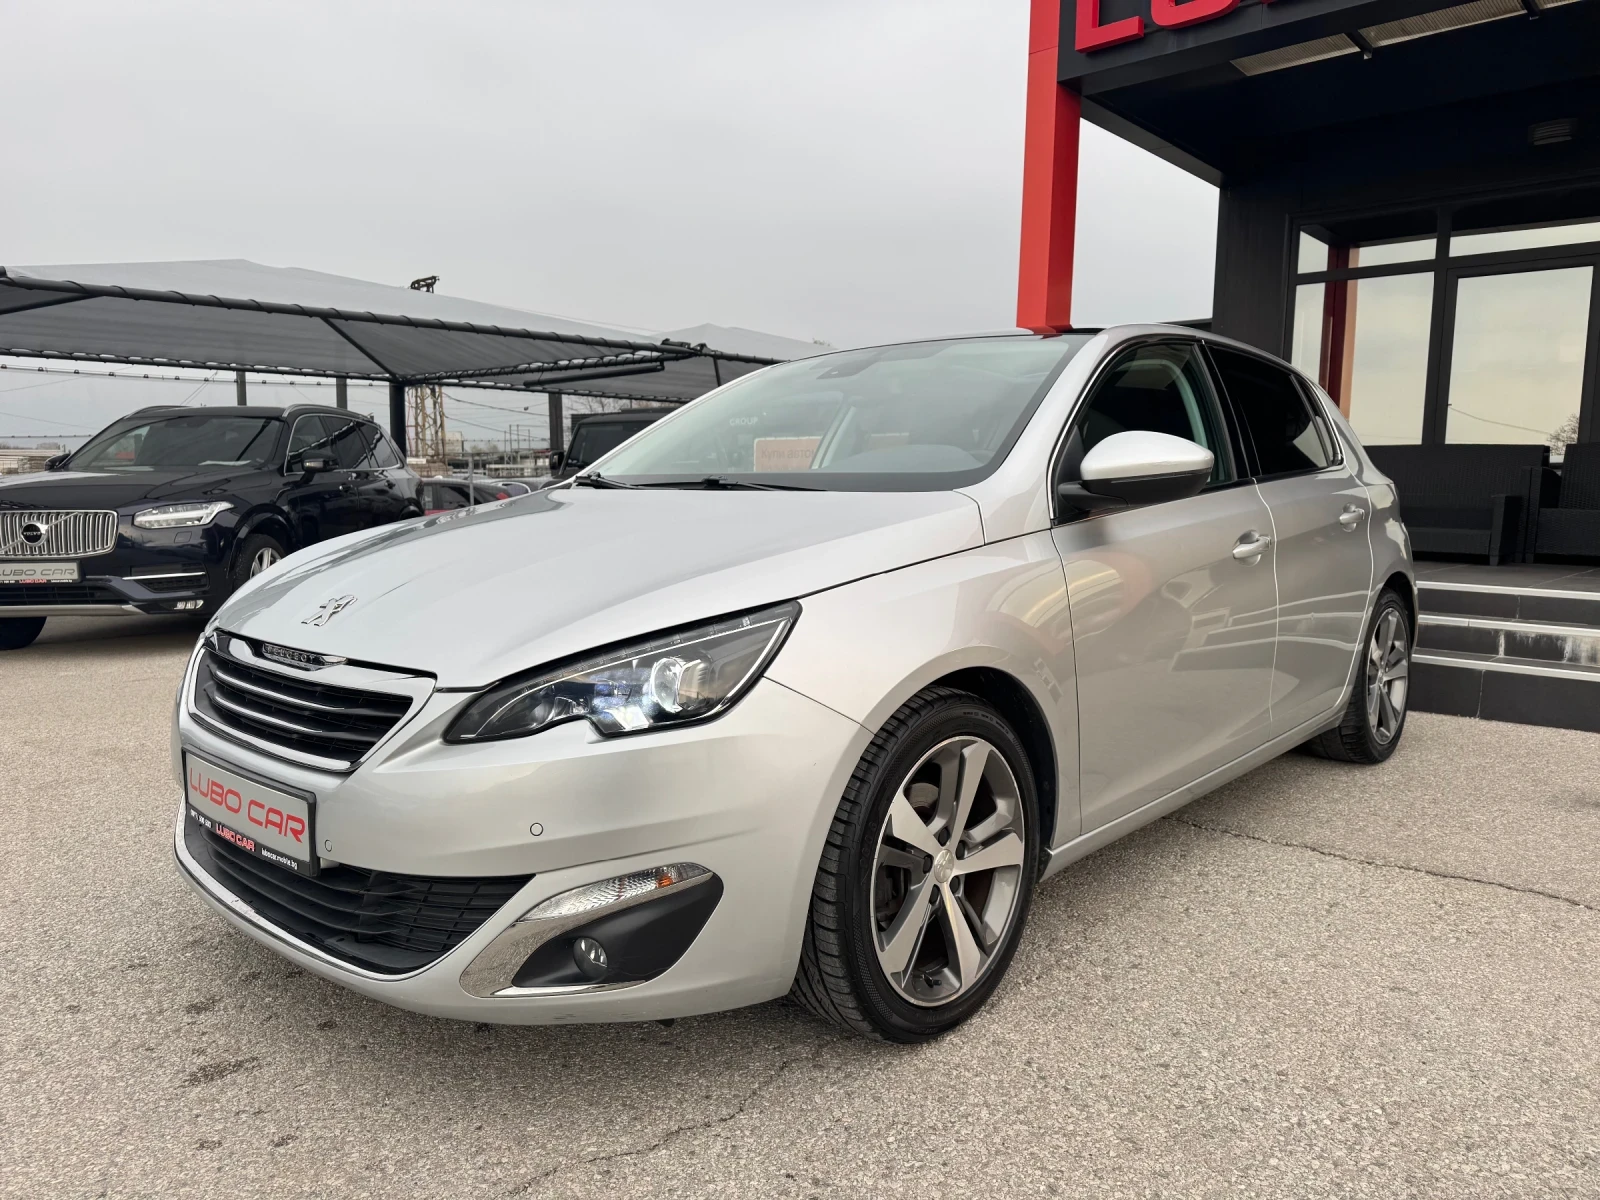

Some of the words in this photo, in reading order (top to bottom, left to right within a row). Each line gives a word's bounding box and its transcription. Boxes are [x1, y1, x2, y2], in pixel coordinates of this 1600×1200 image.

[729, 416, 759, 427] GROUP
[761, 448, 785, 461] Купи
[40, 568, 76, 577] CAR
[267, 645, 316, 664] PEUGEOT
[189, 767, 242, 815] LUBO
[247, 799, 306, 844] CAR
[215, 823, 236, 843] LUBO
[235, 834, 256, 852] CAR
